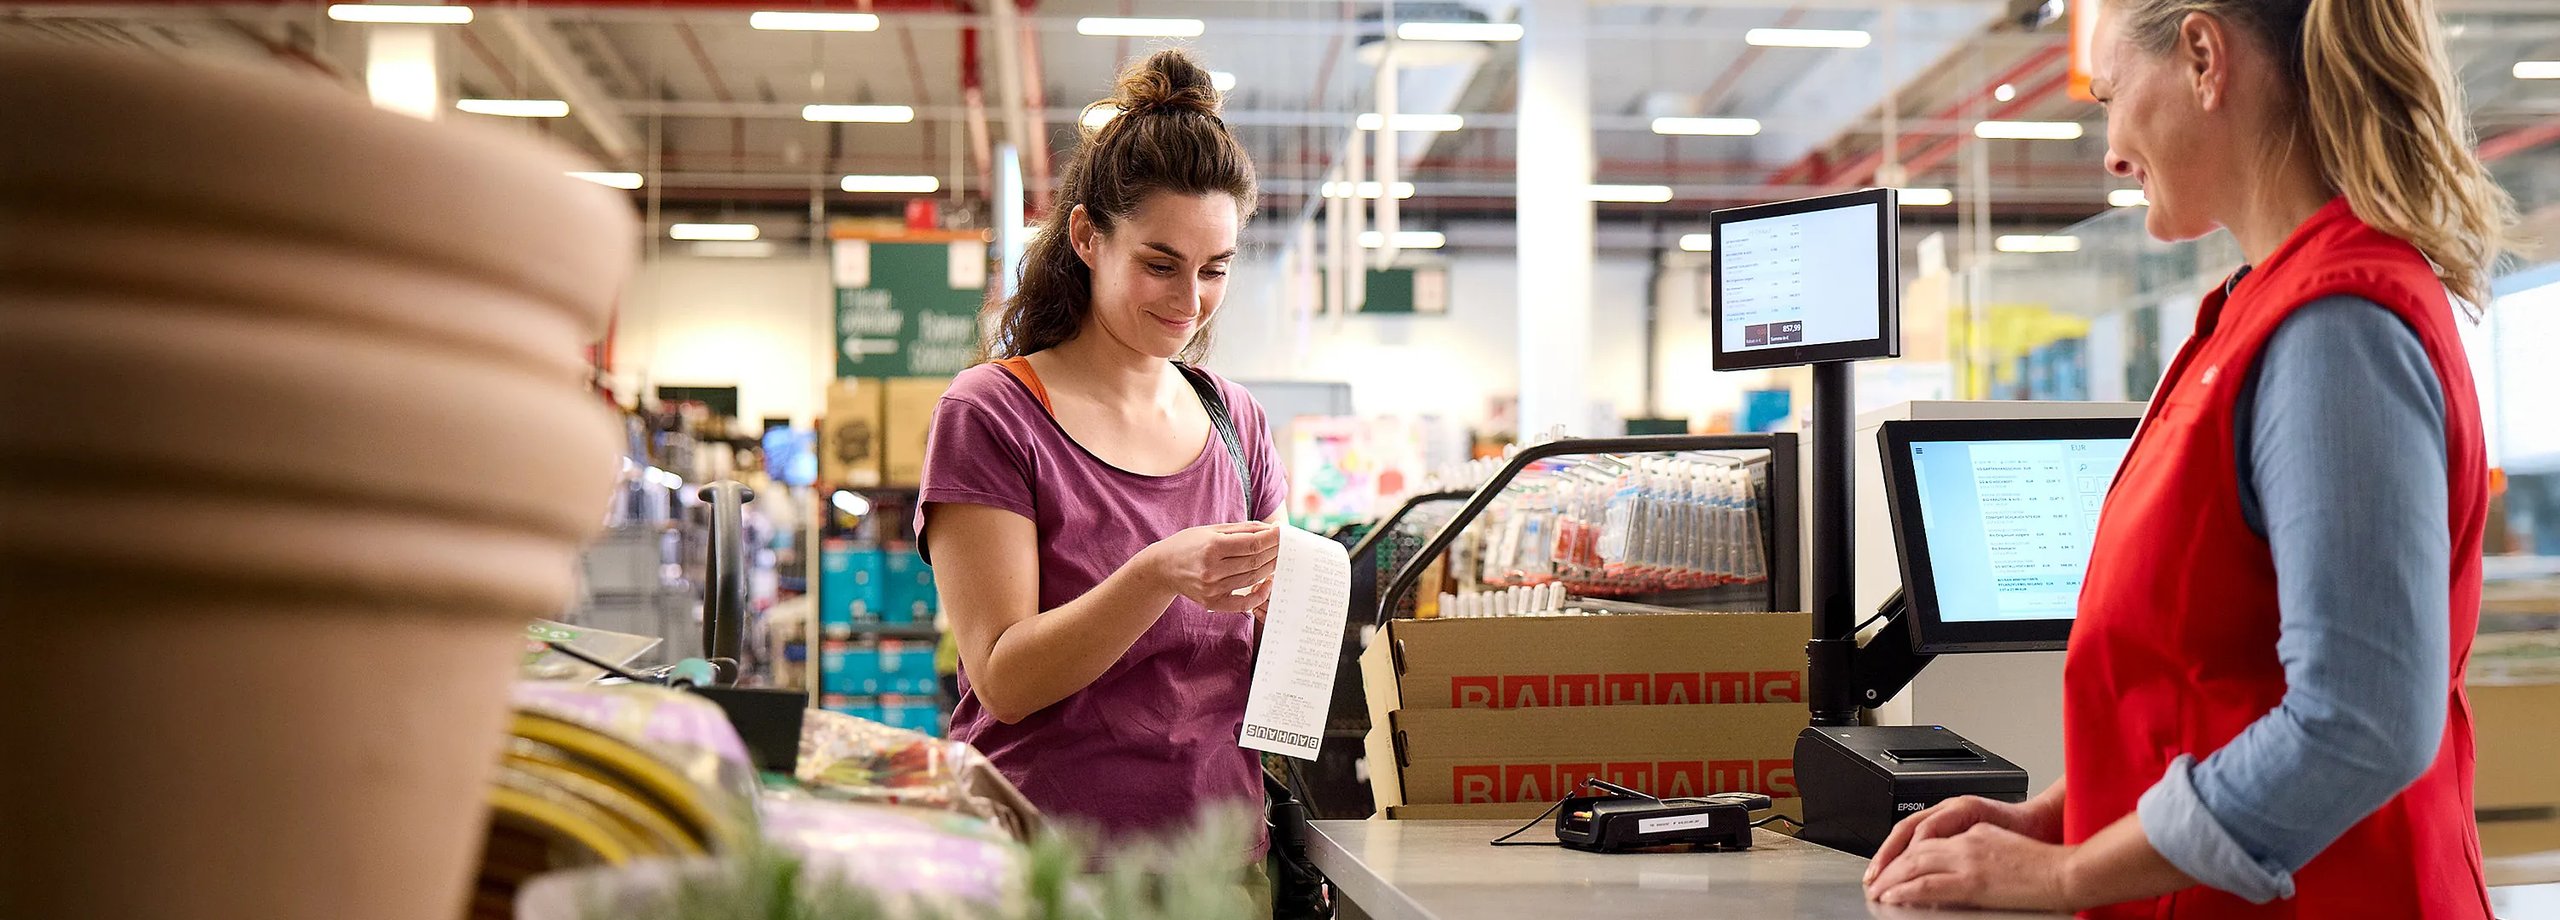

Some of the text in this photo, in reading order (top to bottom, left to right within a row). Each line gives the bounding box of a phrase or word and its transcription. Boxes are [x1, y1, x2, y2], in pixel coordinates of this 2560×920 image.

[1782, 324, 1801, 333] 857,99
[1246, 724, 1320, 750] BAUHAUS
[1897, 802, 1925, 812] EPSON
